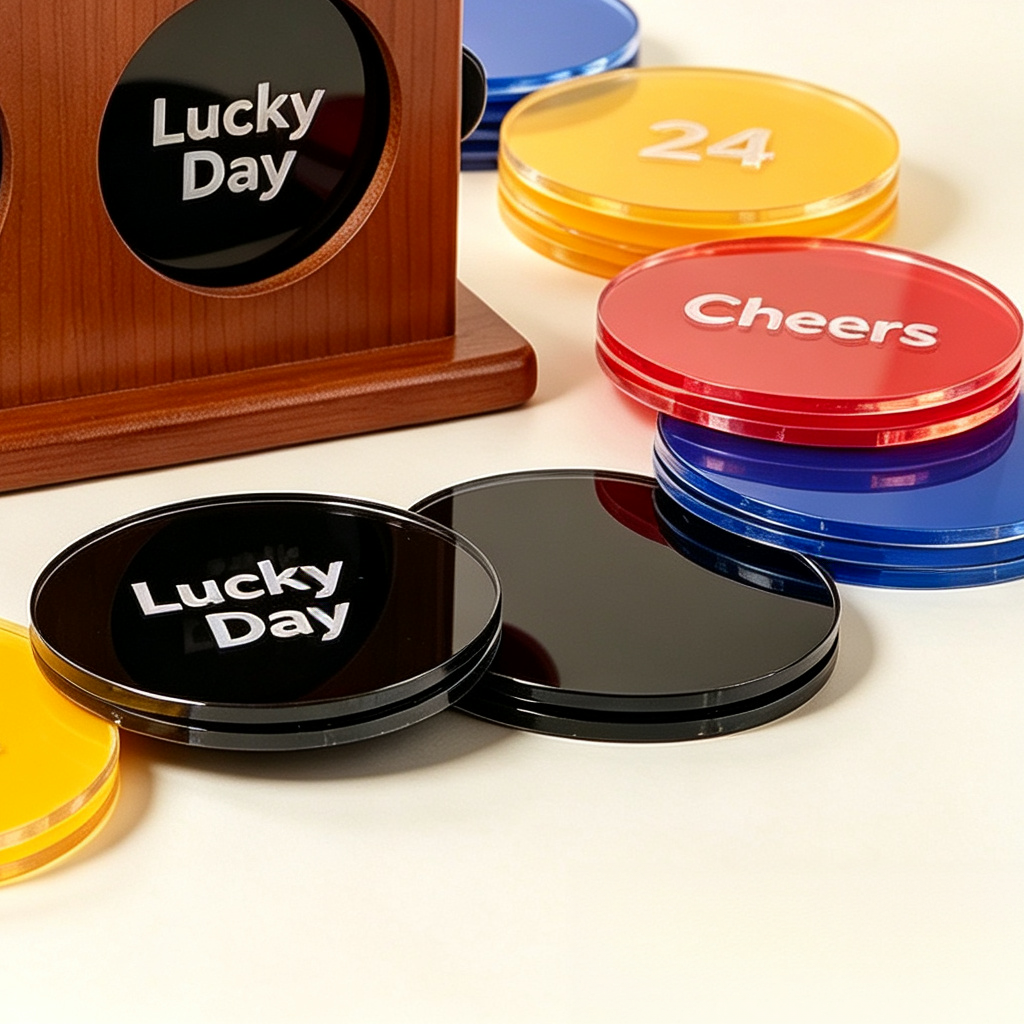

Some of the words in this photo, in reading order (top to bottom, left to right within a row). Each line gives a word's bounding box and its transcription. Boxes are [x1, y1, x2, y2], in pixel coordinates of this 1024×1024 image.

[152, 82, 325, 146] Lucky
[638, 119, 775, 170] 24
[183, 150, 298, 202] Day
[684, 293, 939, 351] Cheers
[131, 559, 345, 616] Lucky
[205, 601, 351, 650] Day
